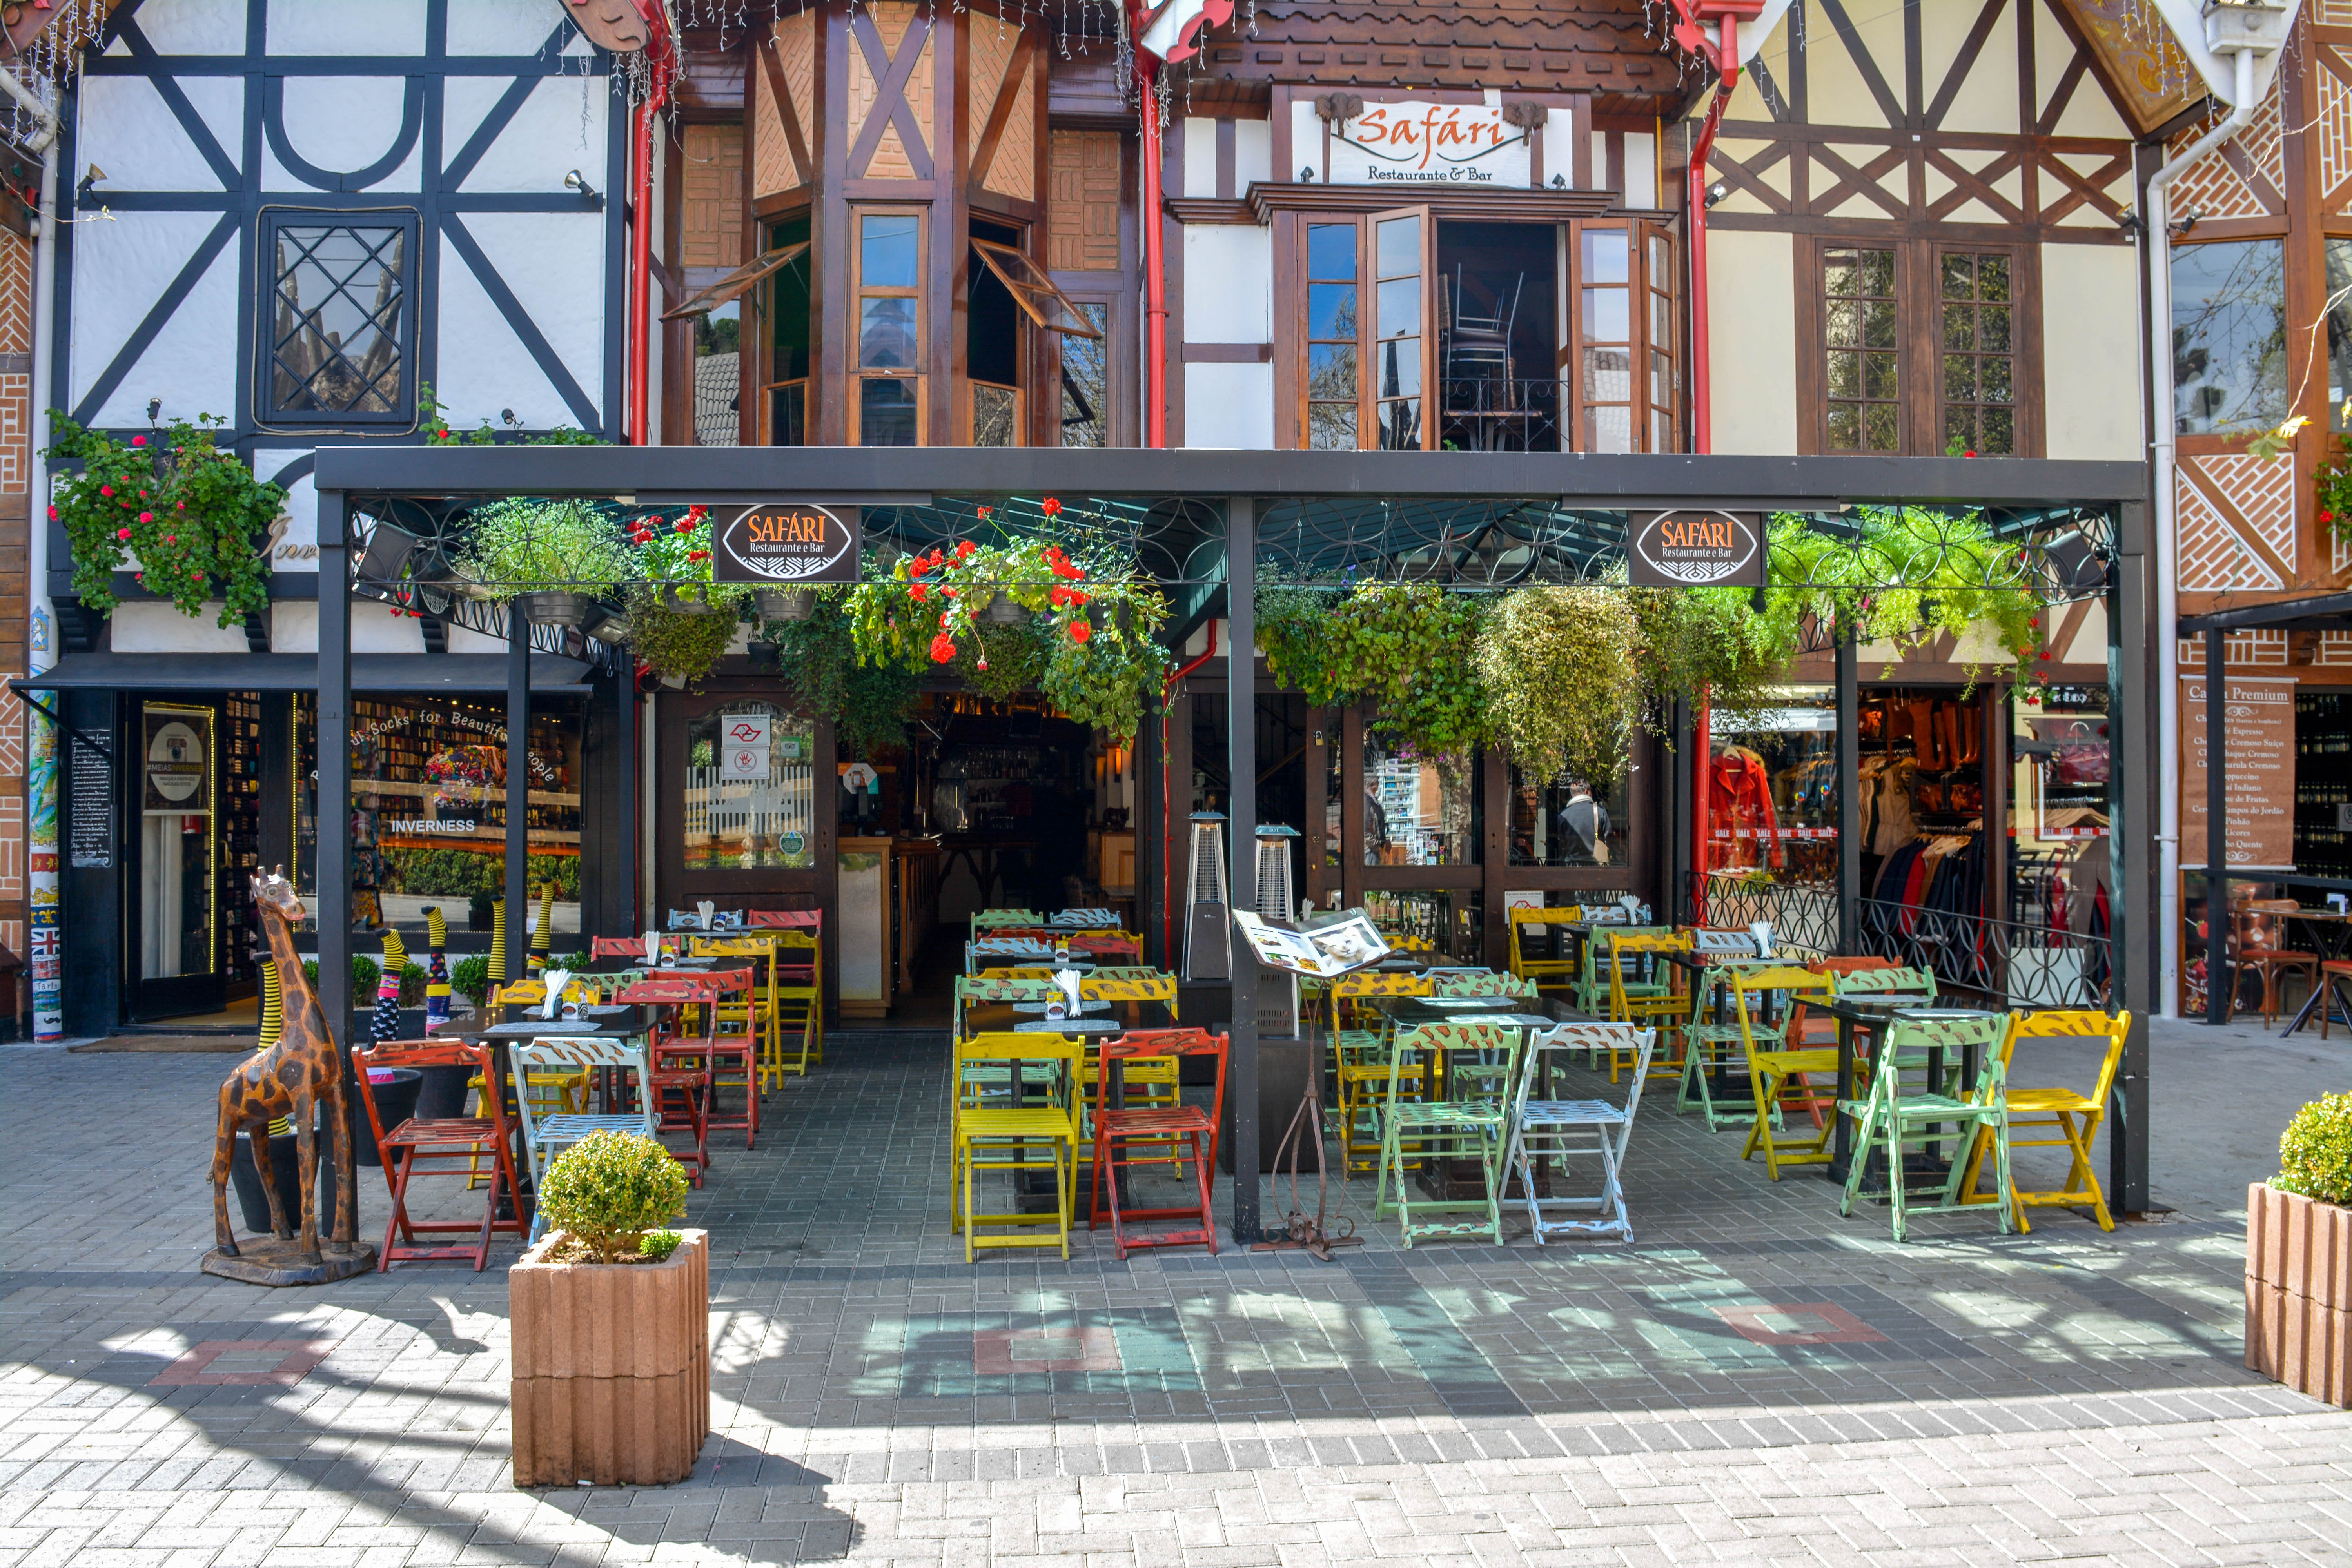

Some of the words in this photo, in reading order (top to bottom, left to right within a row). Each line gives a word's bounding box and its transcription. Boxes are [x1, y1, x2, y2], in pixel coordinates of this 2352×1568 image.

[1357, 106, 1504, 170] Safári
[1368, 166, 1448, 181] Restaurante
[1449, 167, 1465, 181] &
[1467, 167, 1493, 181] Bar
[748, 512, 826, 543] SAFÁRI
[1661, 517, 1733, 548] SAFÁRI
[750, 542, 802, 553] Restaurante
[810, 543, 825, 553] Bar
[1662, 547, 1711, 558] Restaurante
[1718, 548, 1733, 558] Bar
[2232, 687, 2288, 701] Premium
[2232, 727, 2263, 736] Expresso
[370, 715, 410, 735] Socks
[419, 710, 441, 723] for
[451, 711, 508, 743] Beautifu
[528, 751, 554, 782] eople
[2231, 739, 2262, 747] Cremoso
[2263, 739, 2285, 749] Suíço
[2248, 750, 2279, 759] Cremoso
[2249, 761, 2281, 769] Cremoso
[2261, 807, 2285, 815] Jordão
[392, 820, 475, 832] INVERNESS
[2225, 828, 2250, 837] Licores
[2236, 840, 2263, 849] Quente
